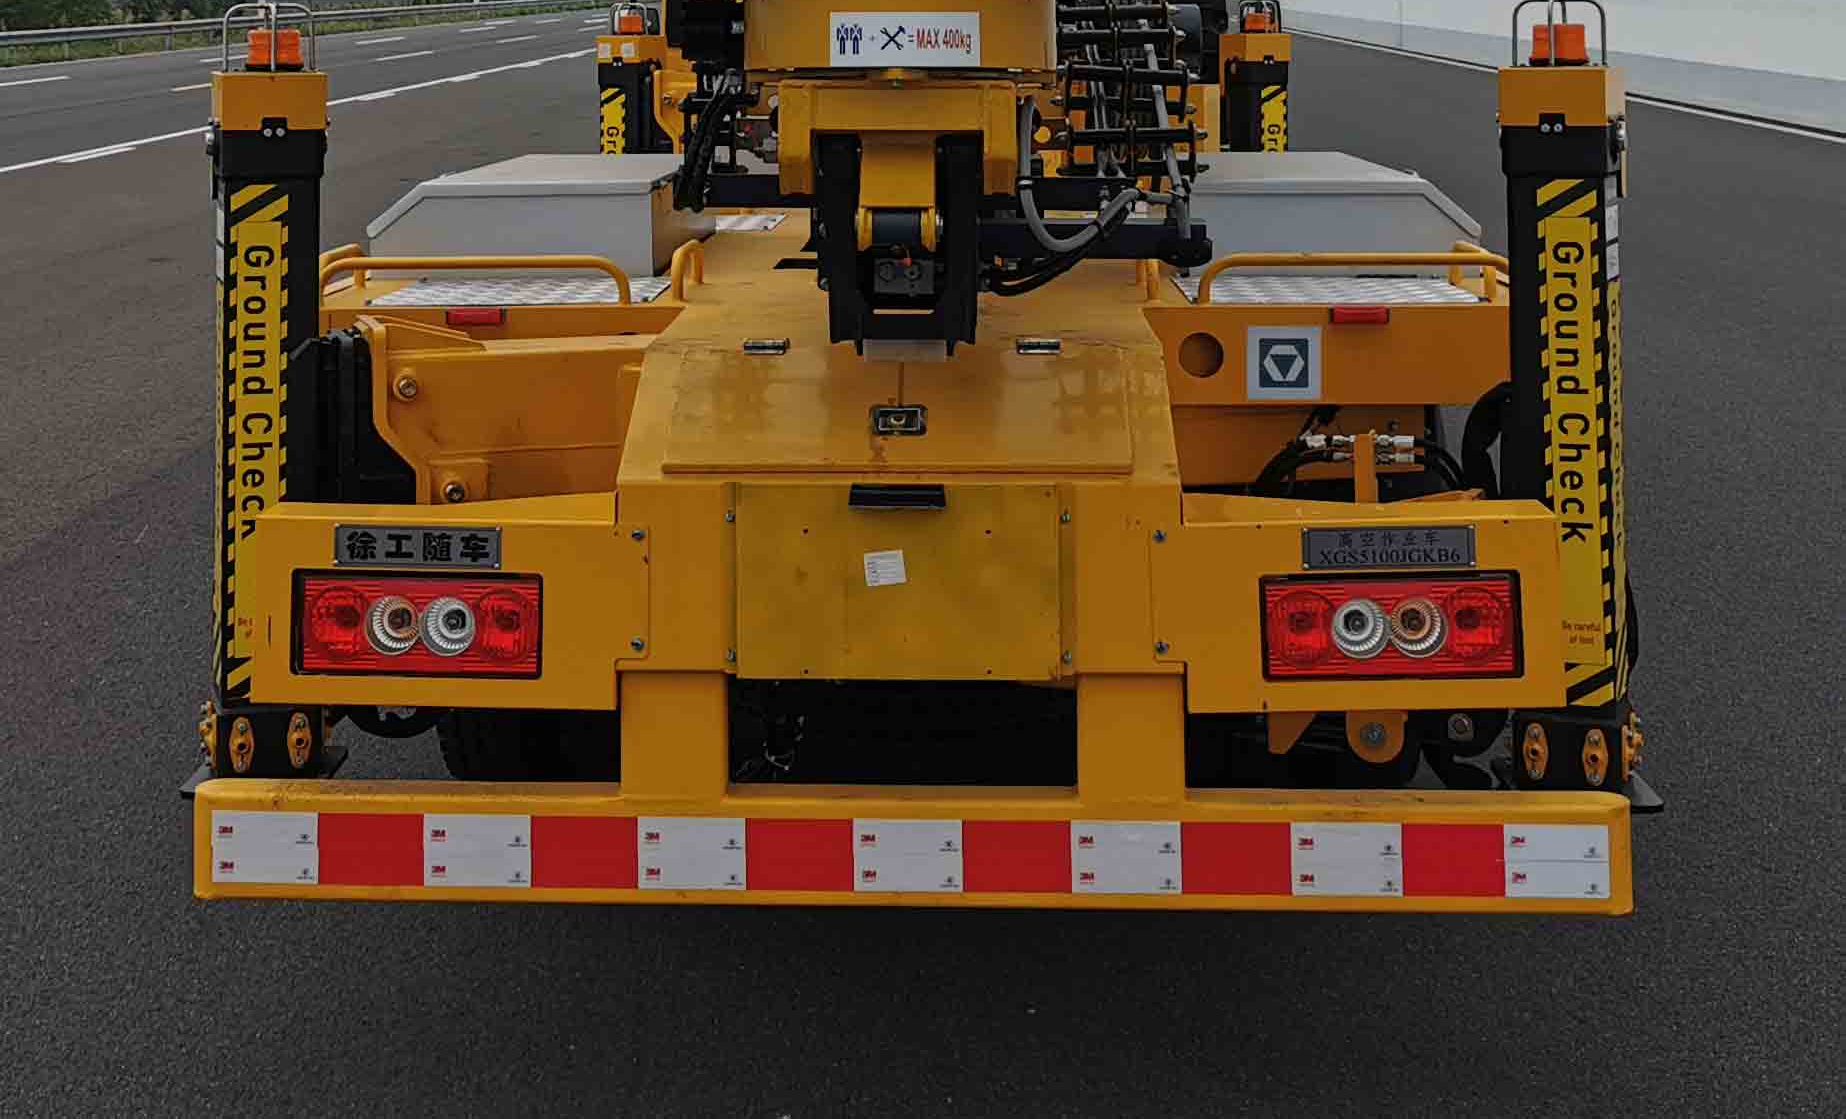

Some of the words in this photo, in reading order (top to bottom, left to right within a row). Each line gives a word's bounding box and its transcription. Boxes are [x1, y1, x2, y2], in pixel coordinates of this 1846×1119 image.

[917, 28, 939, 50] MAX
[943, 28, 971, 54] 400kg
[242, 245, 274, 395] Ground
[1552, 241, 1589, 395] Ground
[1557, 413, 1593, 542] Check
[1319, 548, 1461, 564] XGS5100JGKB6
